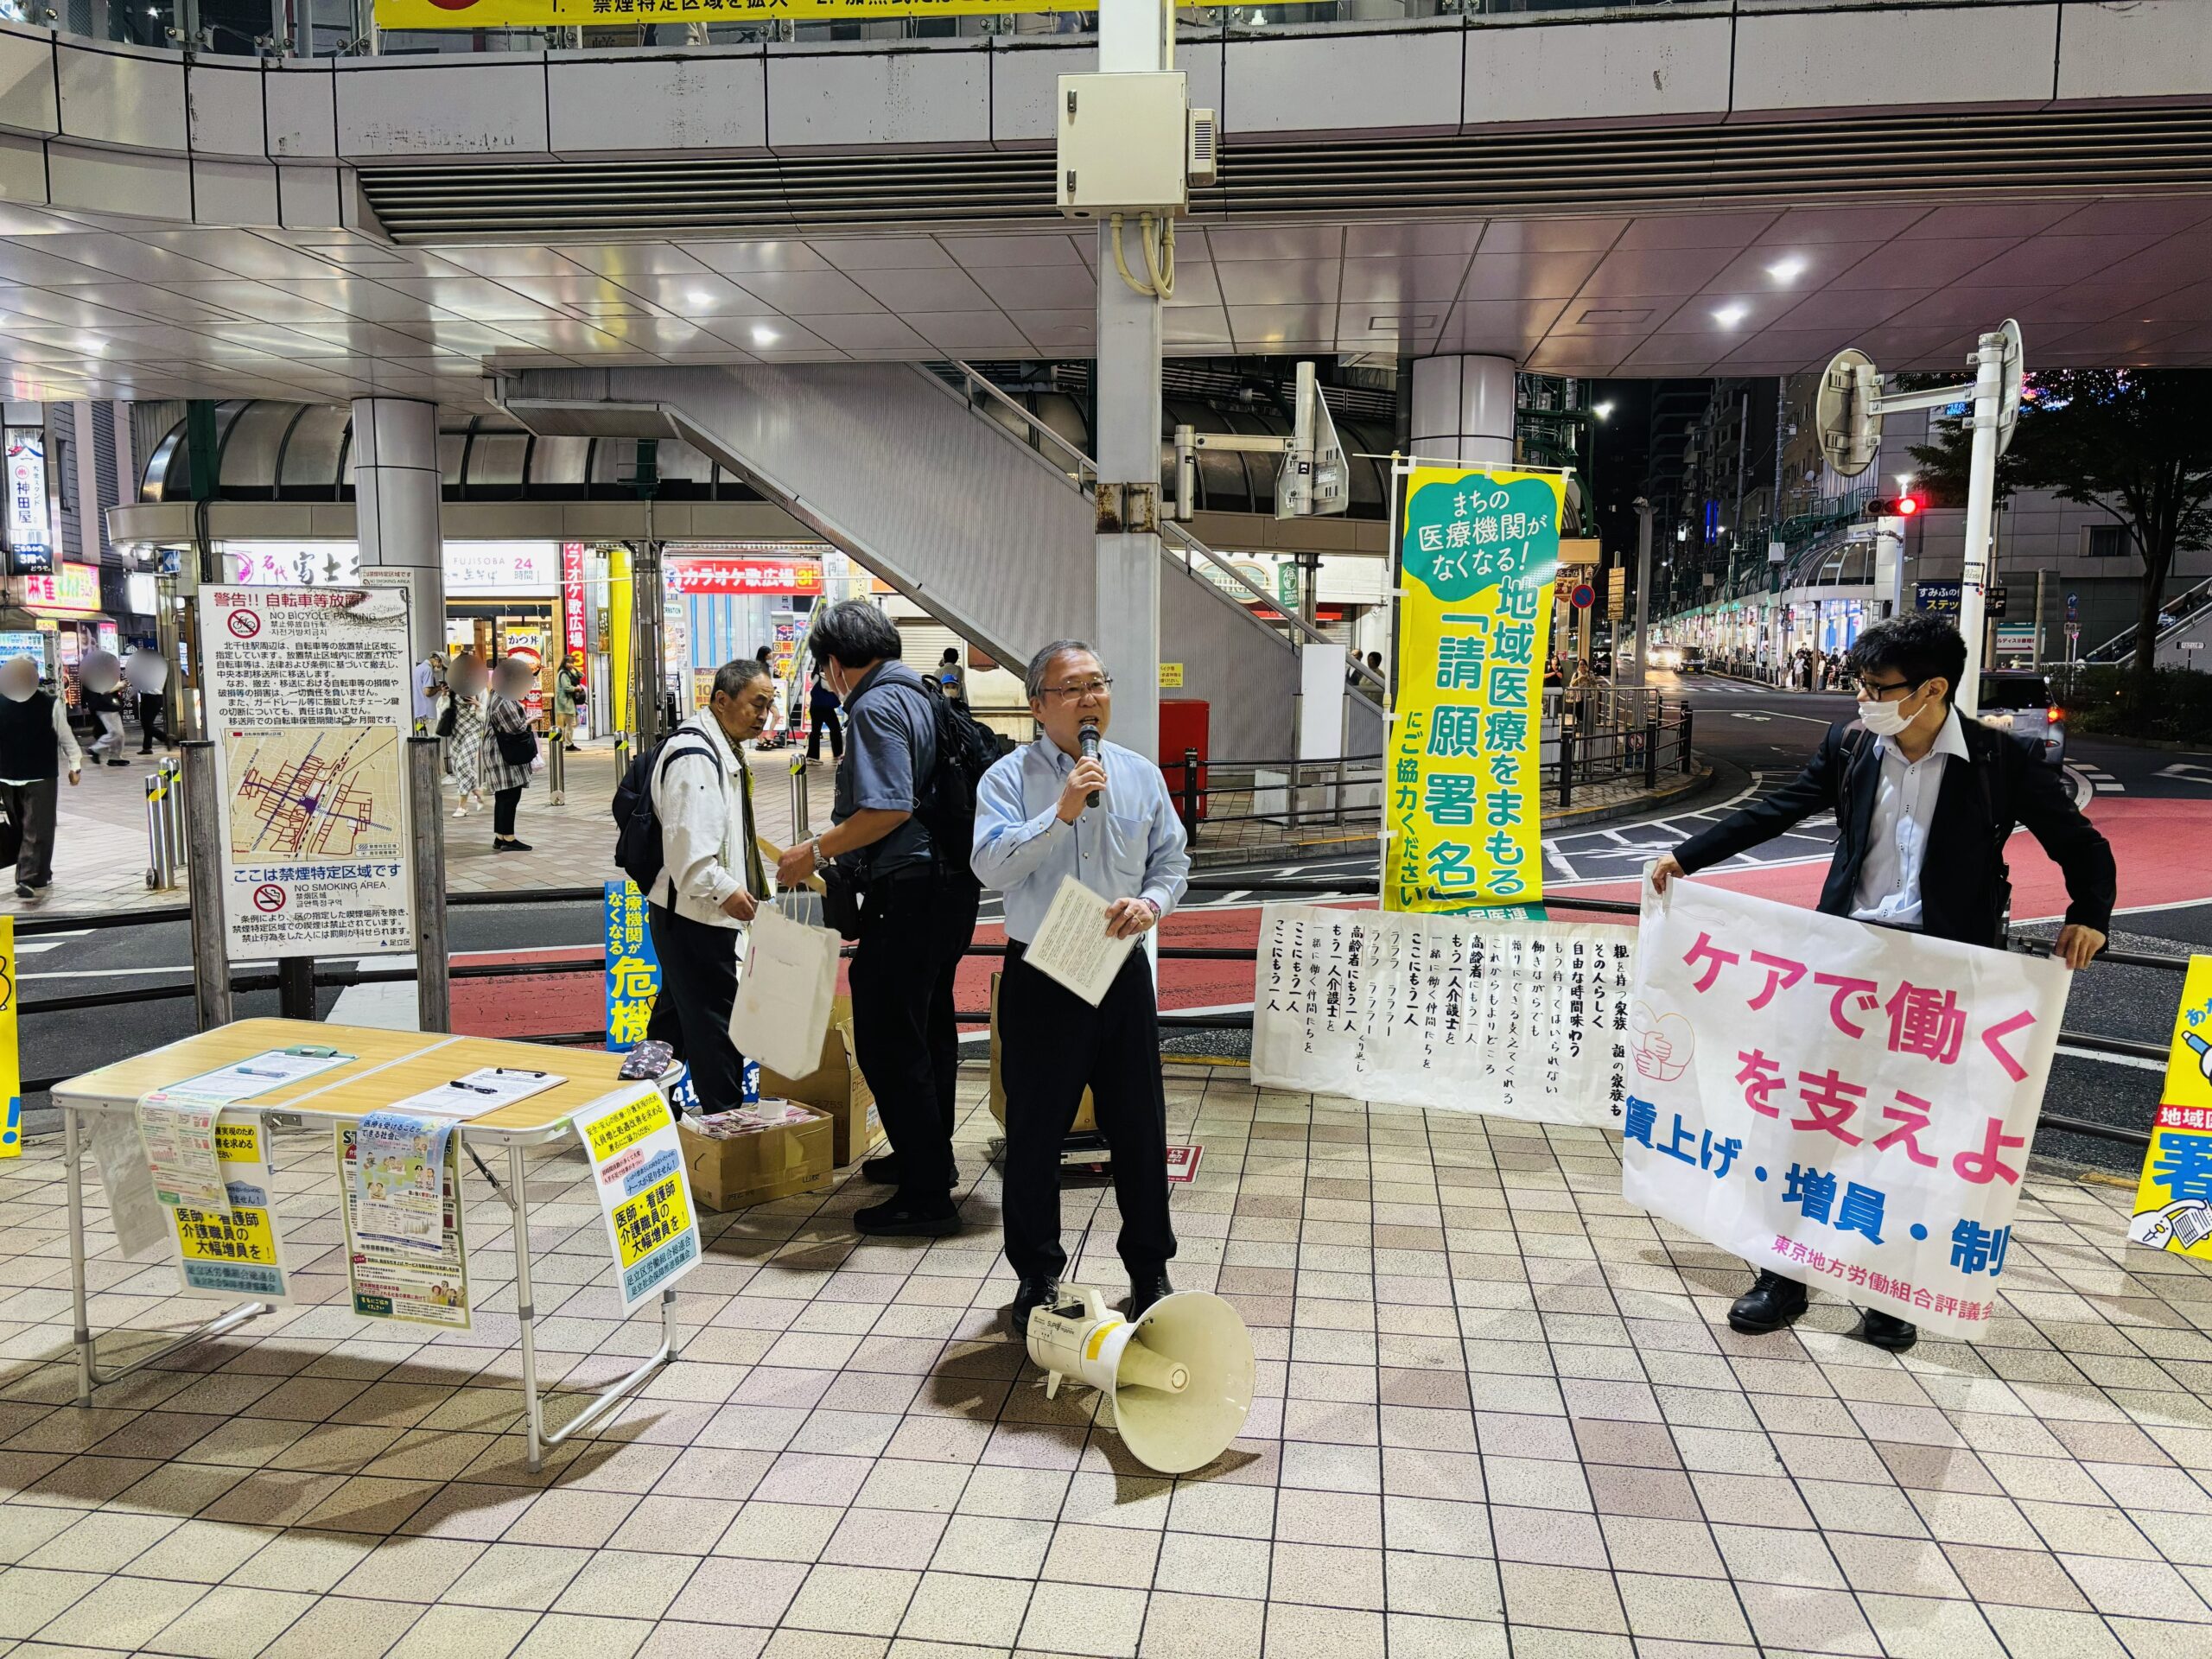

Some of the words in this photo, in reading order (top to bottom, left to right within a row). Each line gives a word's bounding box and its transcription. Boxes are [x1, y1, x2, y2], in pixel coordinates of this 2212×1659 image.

[16, 481, 32, 524] 神田屋
[1452, 490, 1510, 518] まちの
[1419, 512, 1548, 551] 医療機関が
[514, 558, 533, 569] 24
[514, 569, 533, 581] 時間
[683, 567, 795, 587] カラオケ歌広場
[798, 570, 818, 586] 3F
[1432, 541, 1530, 582] なくなる!
[214, 592, 259, 607] 警告!!
[266, 593, 372, 607] 自転車等放置
[1917, 588, 1960, 598] すみふの
[1926, 600, 1960, 611] ステッ
[288, 611, 331, 620] BICYCLE
[334, 612, 376, 620] PARKING
[508, 635, 539, 646] かつ丼
[228, 715, 397, 726] 移送所での自転車保管期間はヶ月間です。
[1485, 575, 1539, 895] 地域医療をまもる
[1424, 613, 1490, 901] 「請願署名」
[1395, 711, 1424, 906] にご協力ください
[233, 863, 402, 883] ここは禁煙特定区域です
[312, 883, 357, 892] SMOKING
[359, 880, 386, 889] AREA
[607, 891, 624, 956] なくなる
[624, 880, 644, 954] 医療機関が
[1452, 906, 1529, 920] 民医連
[1266, 919, 1285, 1012] ここにもう一人
[1286, 922, 1304, 1013] ここにもう一人
[1370, 930, 1381, 967] ラララ
[1389, 931, 1400, 969] ラララ
[1304, 926, 1324, 1053] 一緒に働く仲間たちを
[1326, 924, 1342, 1032] もう一人介護士を
[1344, 925, 1363, 1032] 高齢者にもう一人
[1403, 932, 1421, 1027] ここにもう一人
[1445, 934, 1463, 1045] もう一人介護士を
[1465, 935, 1484, 1044] 高齢者にもう一人
[1531, 940, 1546, 1037] 働きながらでも
[1568, 940, 1585, 1058] 自由な時間味わう
[1592, 944, 1607, 1028] その人らしく
[1612, 944, 1630, 1031] 親を持つ家族
[609, 955, 658, 1045] 危機
[1423, 937, 1443, 1069] 一緒に働く仲間たちを
[1485, 938, 1502, 1074] これからもよりどころ
[1503, 939, 1522, 1104] 頼りにできる支えてくれる
[1546, 942, 1563, 1094] もう待ってはいられない
[1681, 931, 2038, 1084] ケアで働く
[362, 1129, 400, 1141] できる社会に
[363, 1119, 422, 1134] 医療を受けることが
[594, 1105, 663, 1148] 人員増と処遇改善を求める
[608, 1124, 652, 1153] 署名にご協力ください
[1734, 1048, 2025, 1187] を支えよ
[177, 1208, 259, 1227] 医師・看護師
[615, 1180, 676, 1229] 医師・看護師
[620, 1203, 670, 1246] 介護職員の
[181, 1224, 249, 1242] 介護職員の
[196, 1240, 261, 1260] 大幅増員を
[632, 1216, 679, 1258] 大幅増員を
[626, 1236, 691, 1287] 足立区労働組合総連合
[1770, 1234, 1994, 1322] 東京地方労働組合評議会
